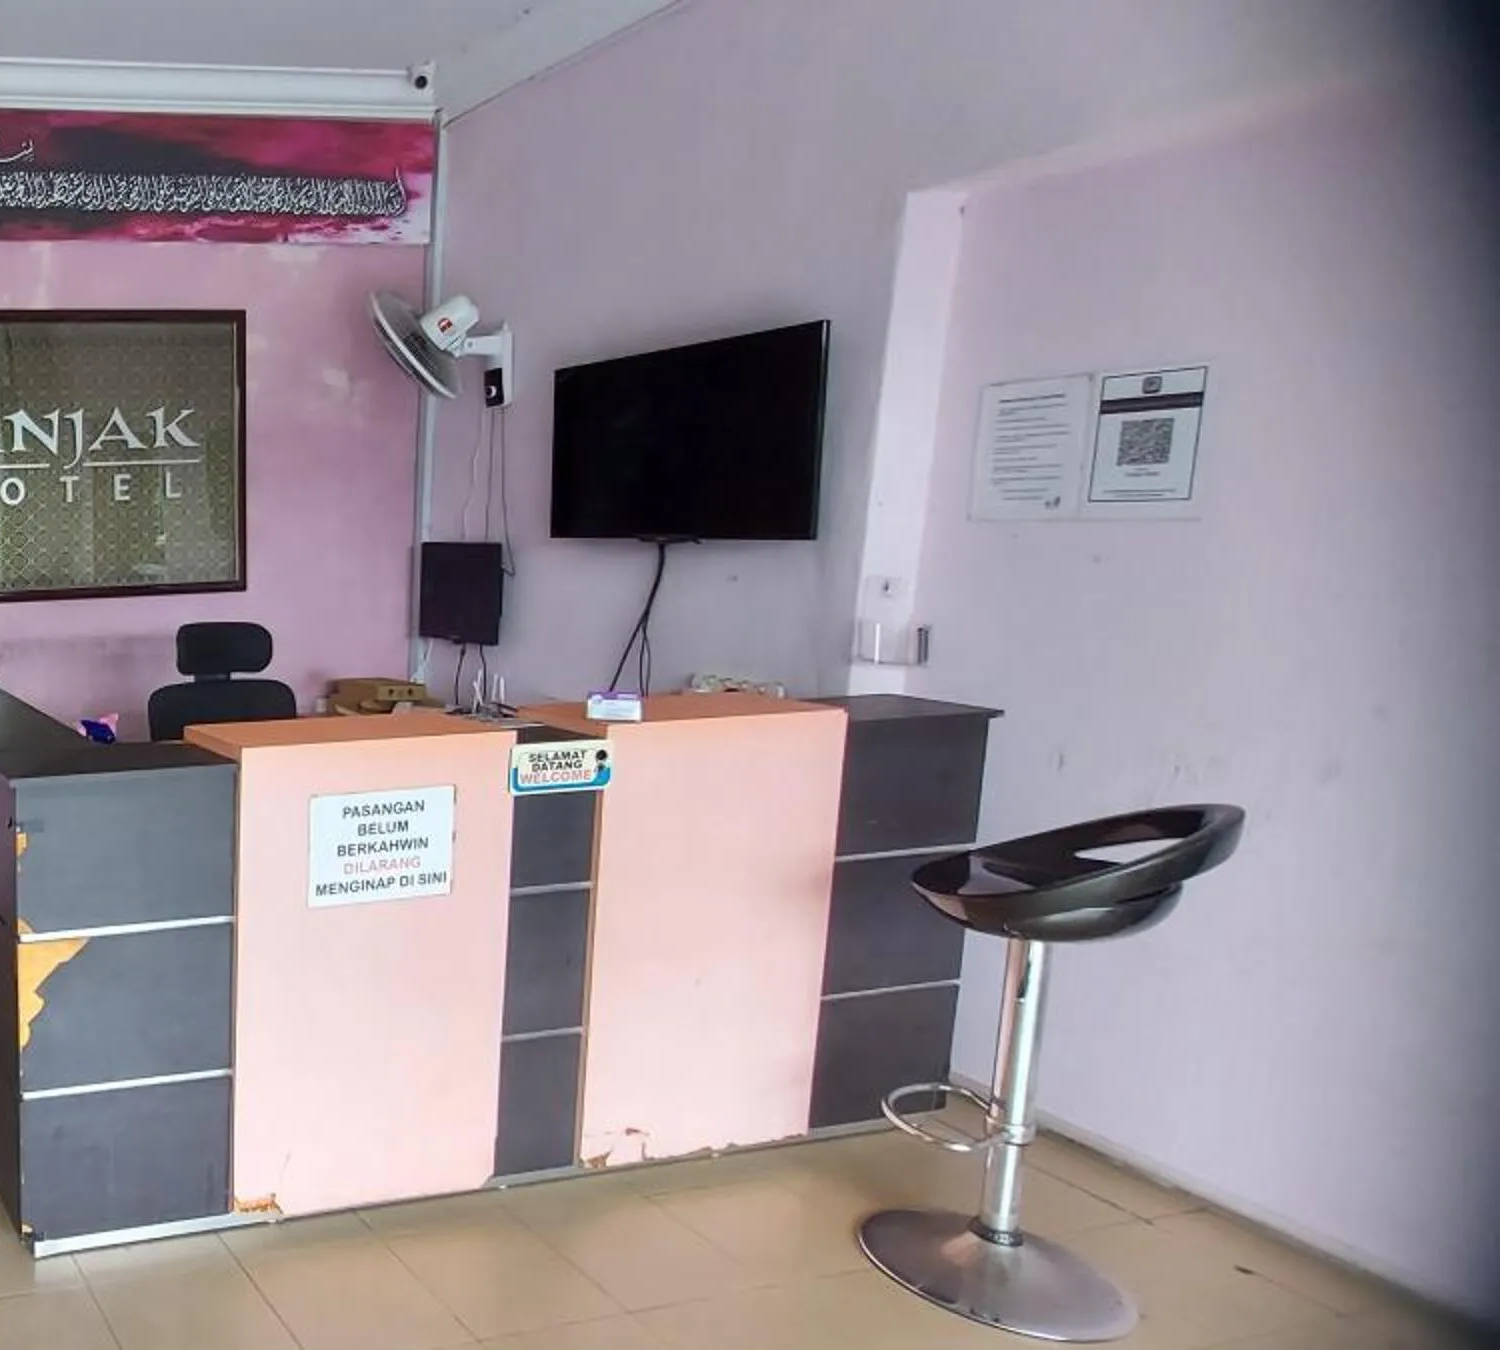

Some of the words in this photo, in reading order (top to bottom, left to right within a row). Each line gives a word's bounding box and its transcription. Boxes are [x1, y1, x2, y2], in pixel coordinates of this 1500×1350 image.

[529, 750, 587, 762] SELAMAT
[531, 760, 582, 772] DATANG
[521, 769, 592, 784] WELCOME
[342, 800, 425, 819] PASANGAN
[358, 820, 409, 836] BELUM
[337, 838, 429, 857] BERKAHWIN
[343, 856, 421, 875] DILARANG
[315, 878, 396, 896] MENGINAP
[400, 875, 414, 887] DI
[418, 872, 447, 885] SINI
